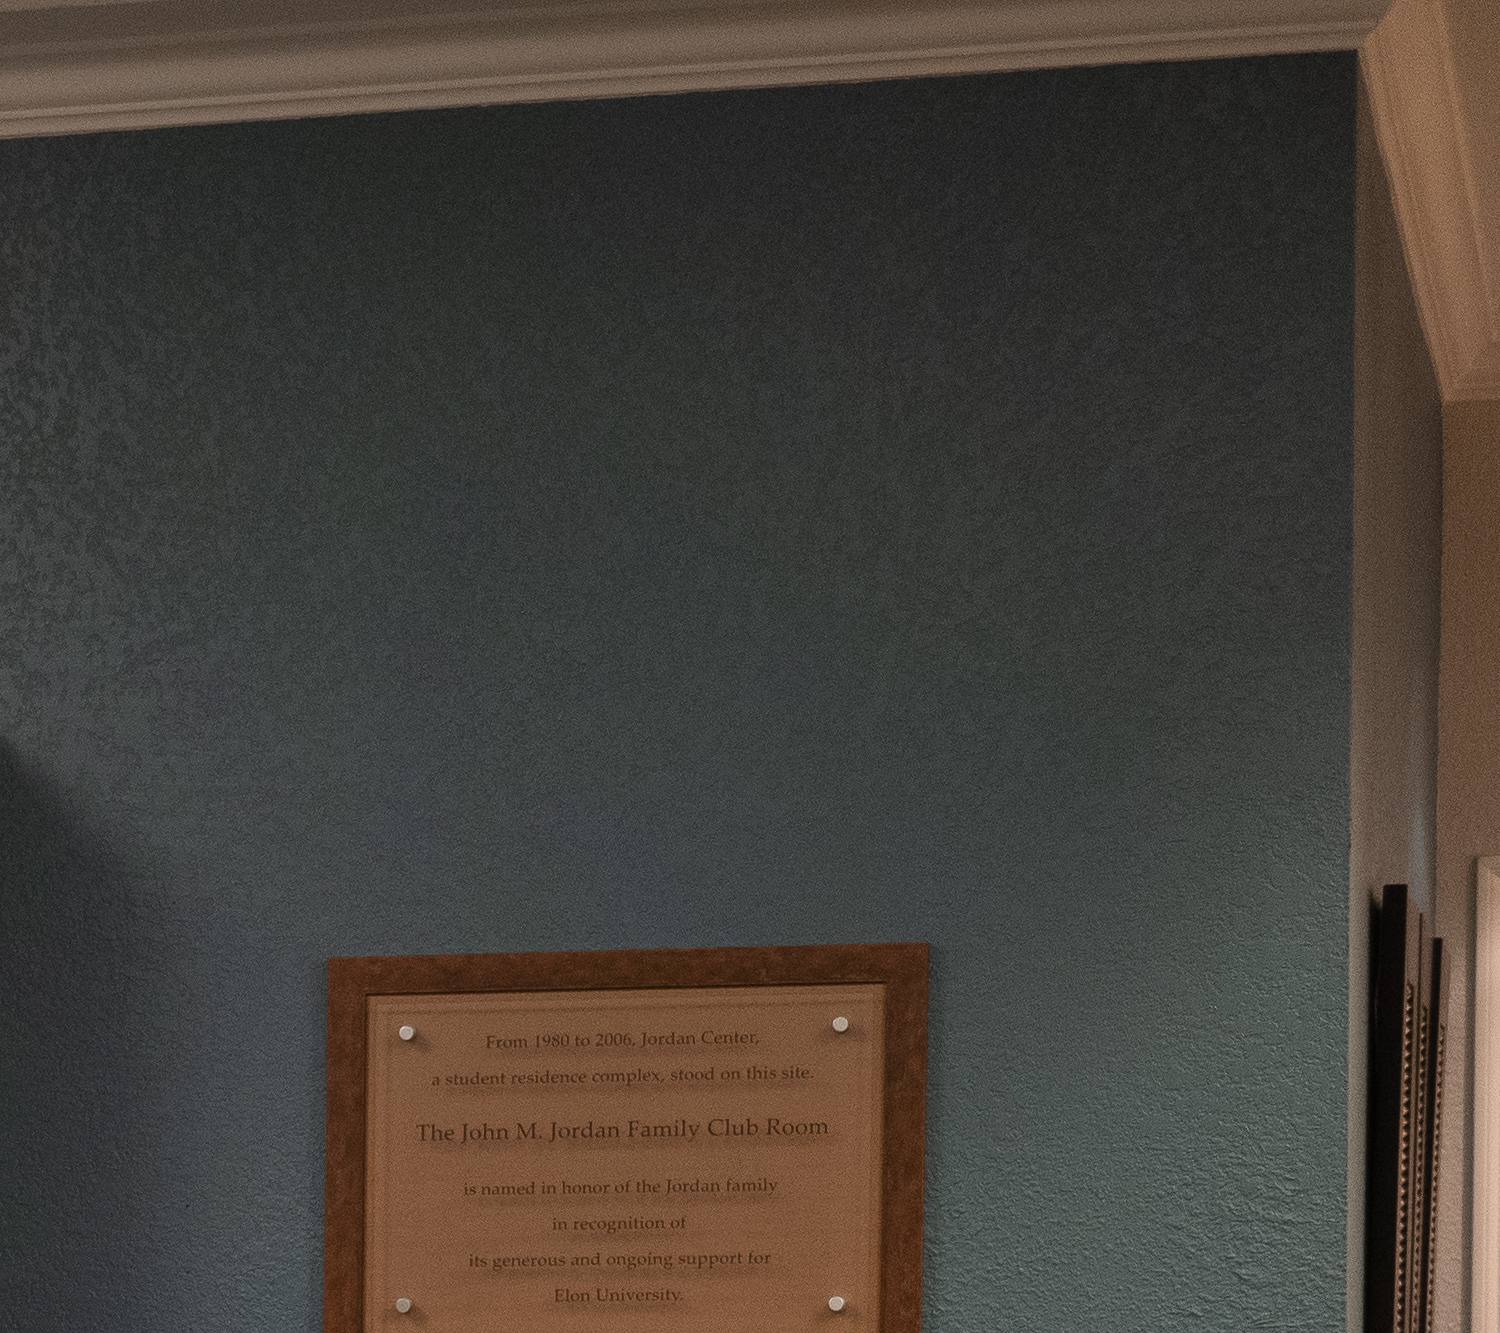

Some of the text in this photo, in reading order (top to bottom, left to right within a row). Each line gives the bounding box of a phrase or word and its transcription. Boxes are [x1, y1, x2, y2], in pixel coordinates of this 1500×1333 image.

[485, 1034, 528, 1049] From
[535, 1033, 570, 1048] 1980
[575, 1034, 591, 1048] to
[640, 1031, 696, 1048] Jordan
[701, 1030, 760, 1045] Center,
[431, 1065, 815, 1087] a student residence complex, stood on this site.
[416, 1117, 829, 1145] The John M. Jordan Family Club Room
[463, 1177, 778, 1197] is named in honor of the Jordan family
[552, 1215, 687, 1235] in recognition of
[468, 1251, 772, 1272] its generous and ongoing support for
[554, 1288, 591, 1303] Elon
